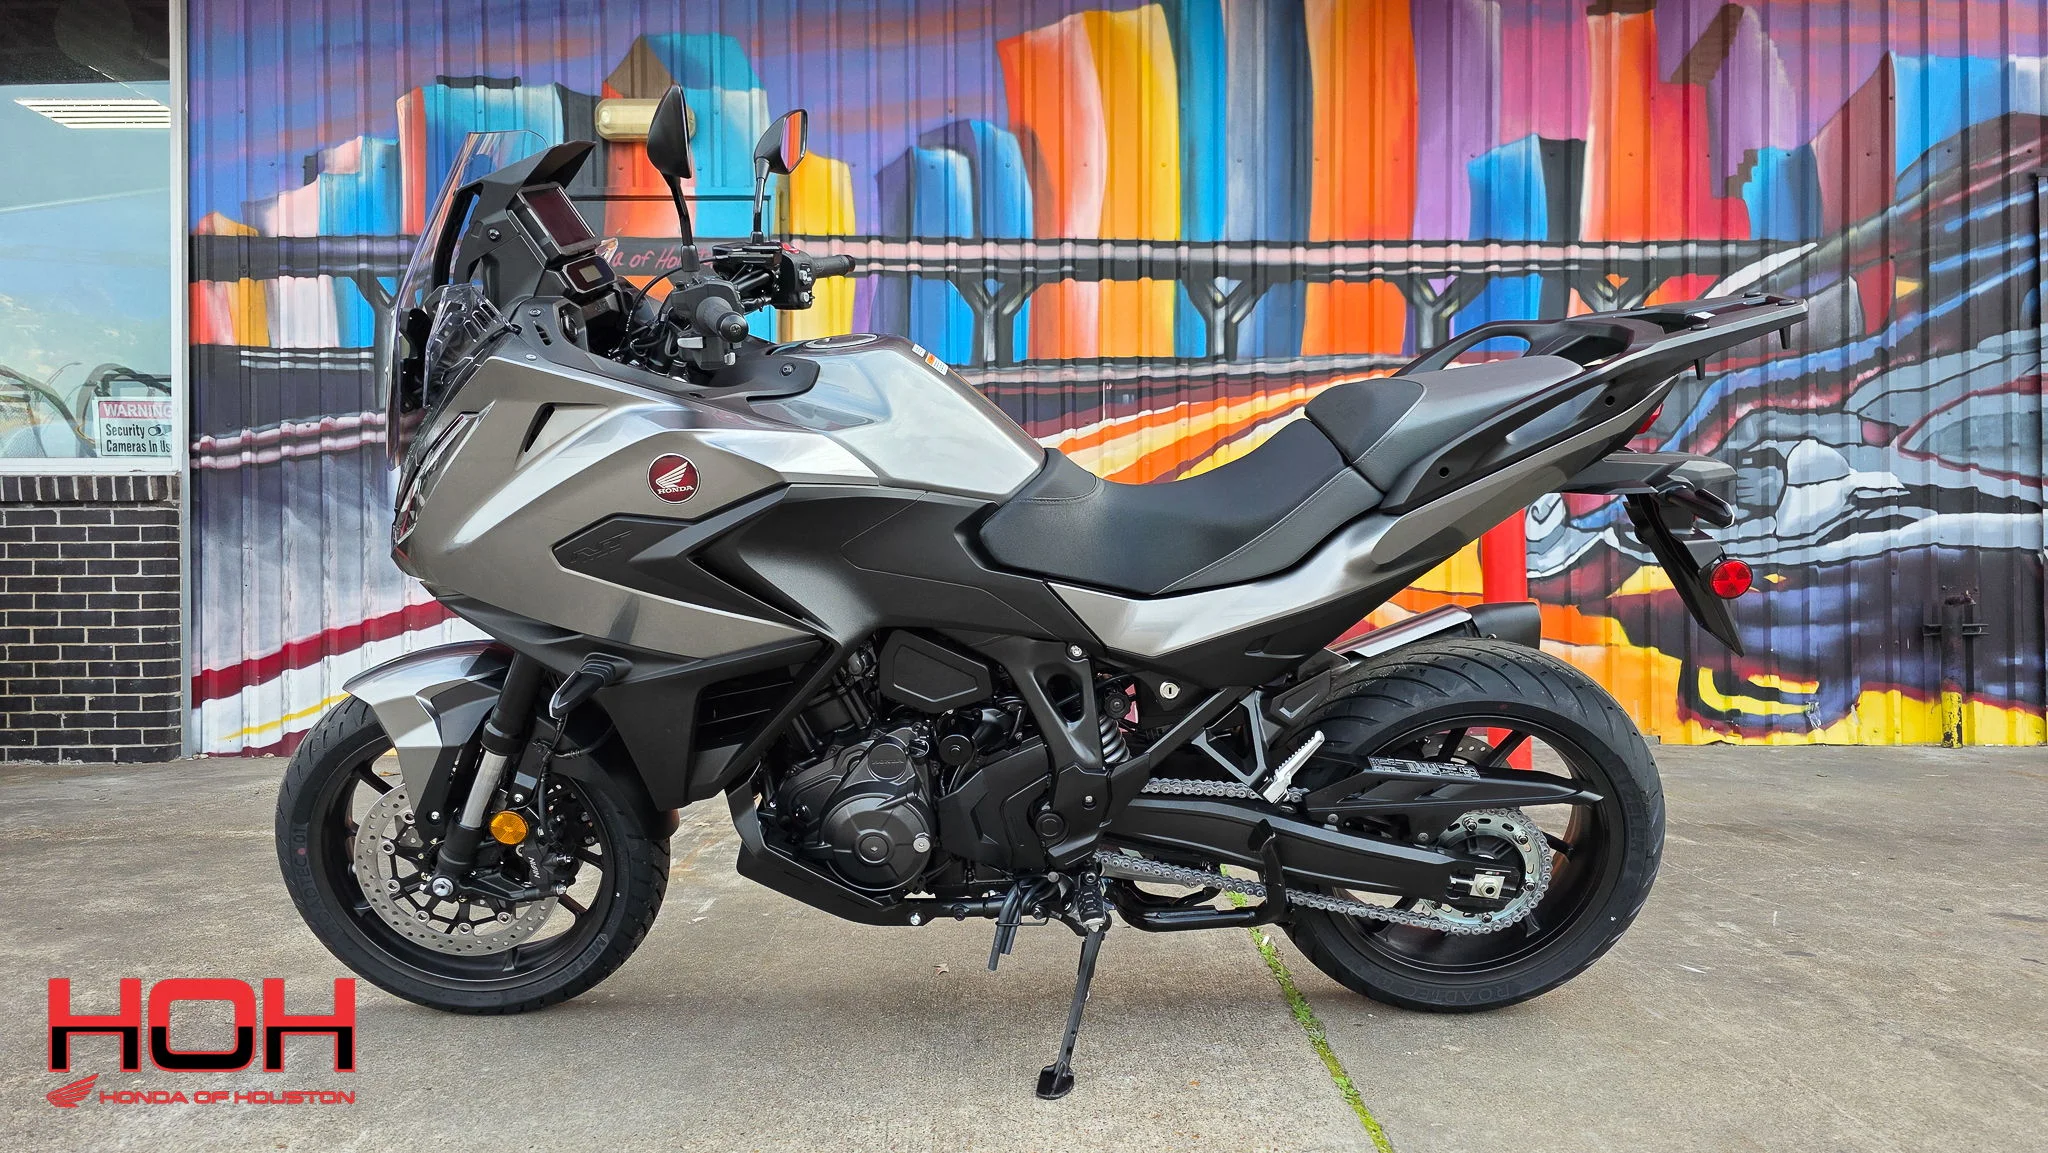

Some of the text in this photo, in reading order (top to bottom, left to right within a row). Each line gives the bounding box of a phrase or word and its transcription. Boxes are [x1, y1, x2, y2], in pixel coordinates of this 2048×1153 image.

[103, 402, 172, 417] WARNING
[105, 424, 145, 438] Security
[106, 440, 172, 452] Cameras In Us
[657, 485, 694, 495] HONDA
